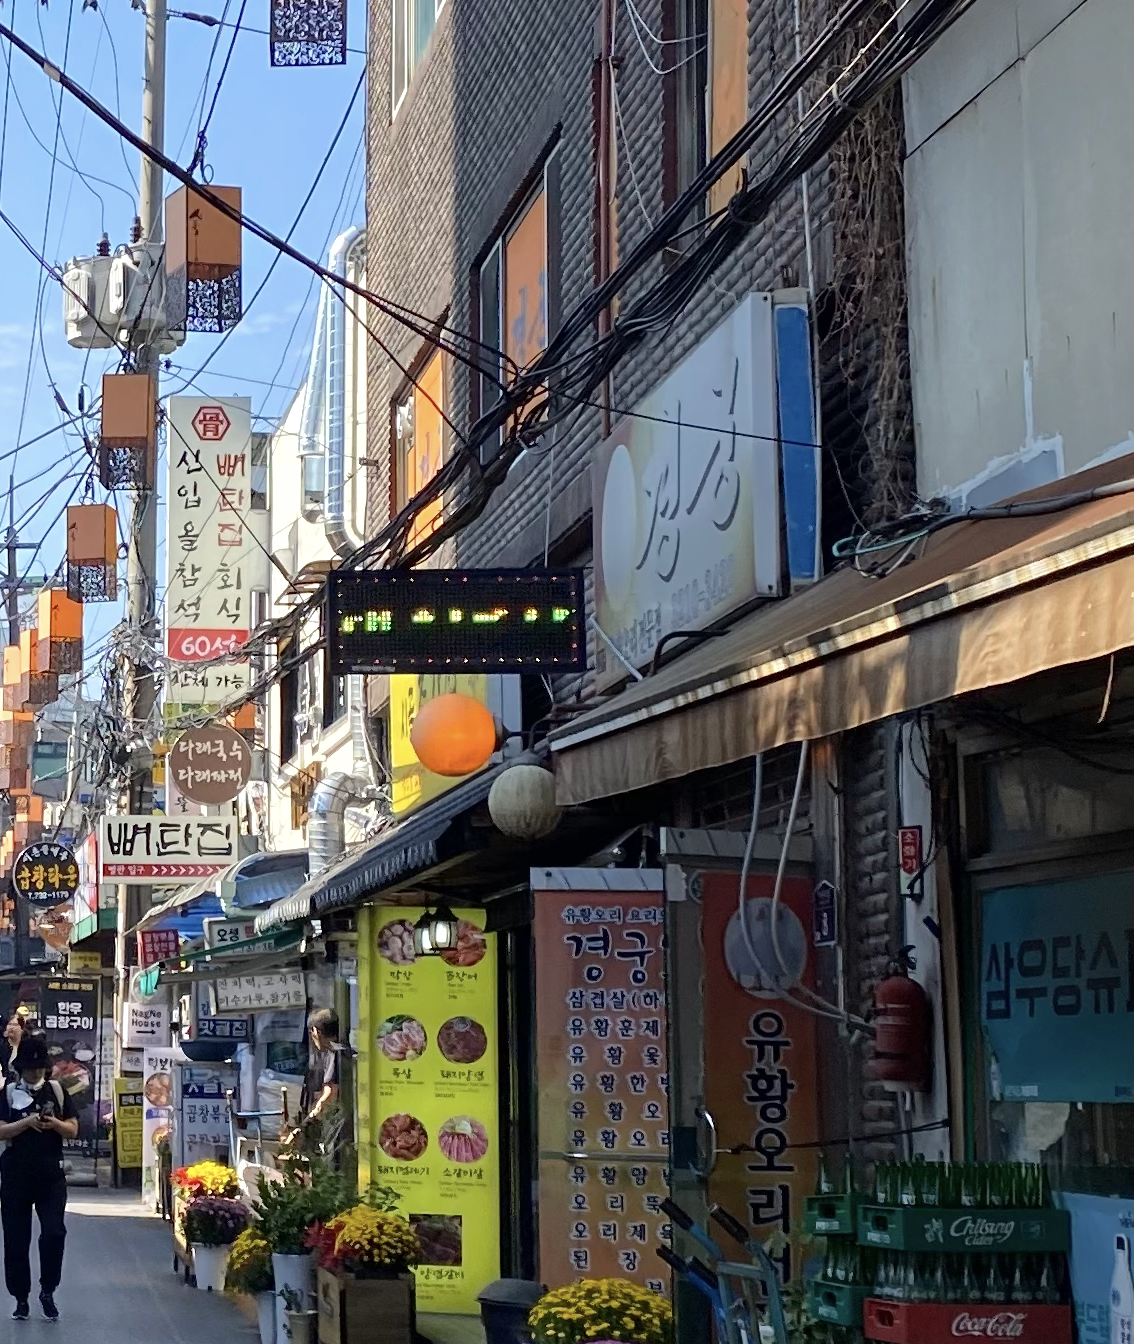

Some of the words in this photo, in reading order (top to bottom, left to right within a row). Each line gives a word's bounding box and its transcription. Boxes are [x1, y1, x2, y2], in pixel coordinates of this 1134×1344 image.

[217, 562, 243, 624] 회식
[216, 670, 245, 689] 가능
[179, 739, 243, 762] 다래국수
[17, 864, 78, 890] 곱창타운
[564, 908, 623, 924] 유황오리
[566, 927, 667, 984] 경궁
[985, 929, 1134, 1019] 삼우당슈
[57, 1001, 83, 1015] 한우
[131, 1019, 161, 1028] House
[569, 1017, 659, 1038] 유황훈제
[571, 1166, 670, 1186] 유황양
[949, 1215, 1015, 1244] Chilsung
[964, 1235, 995, 1246] Cider
